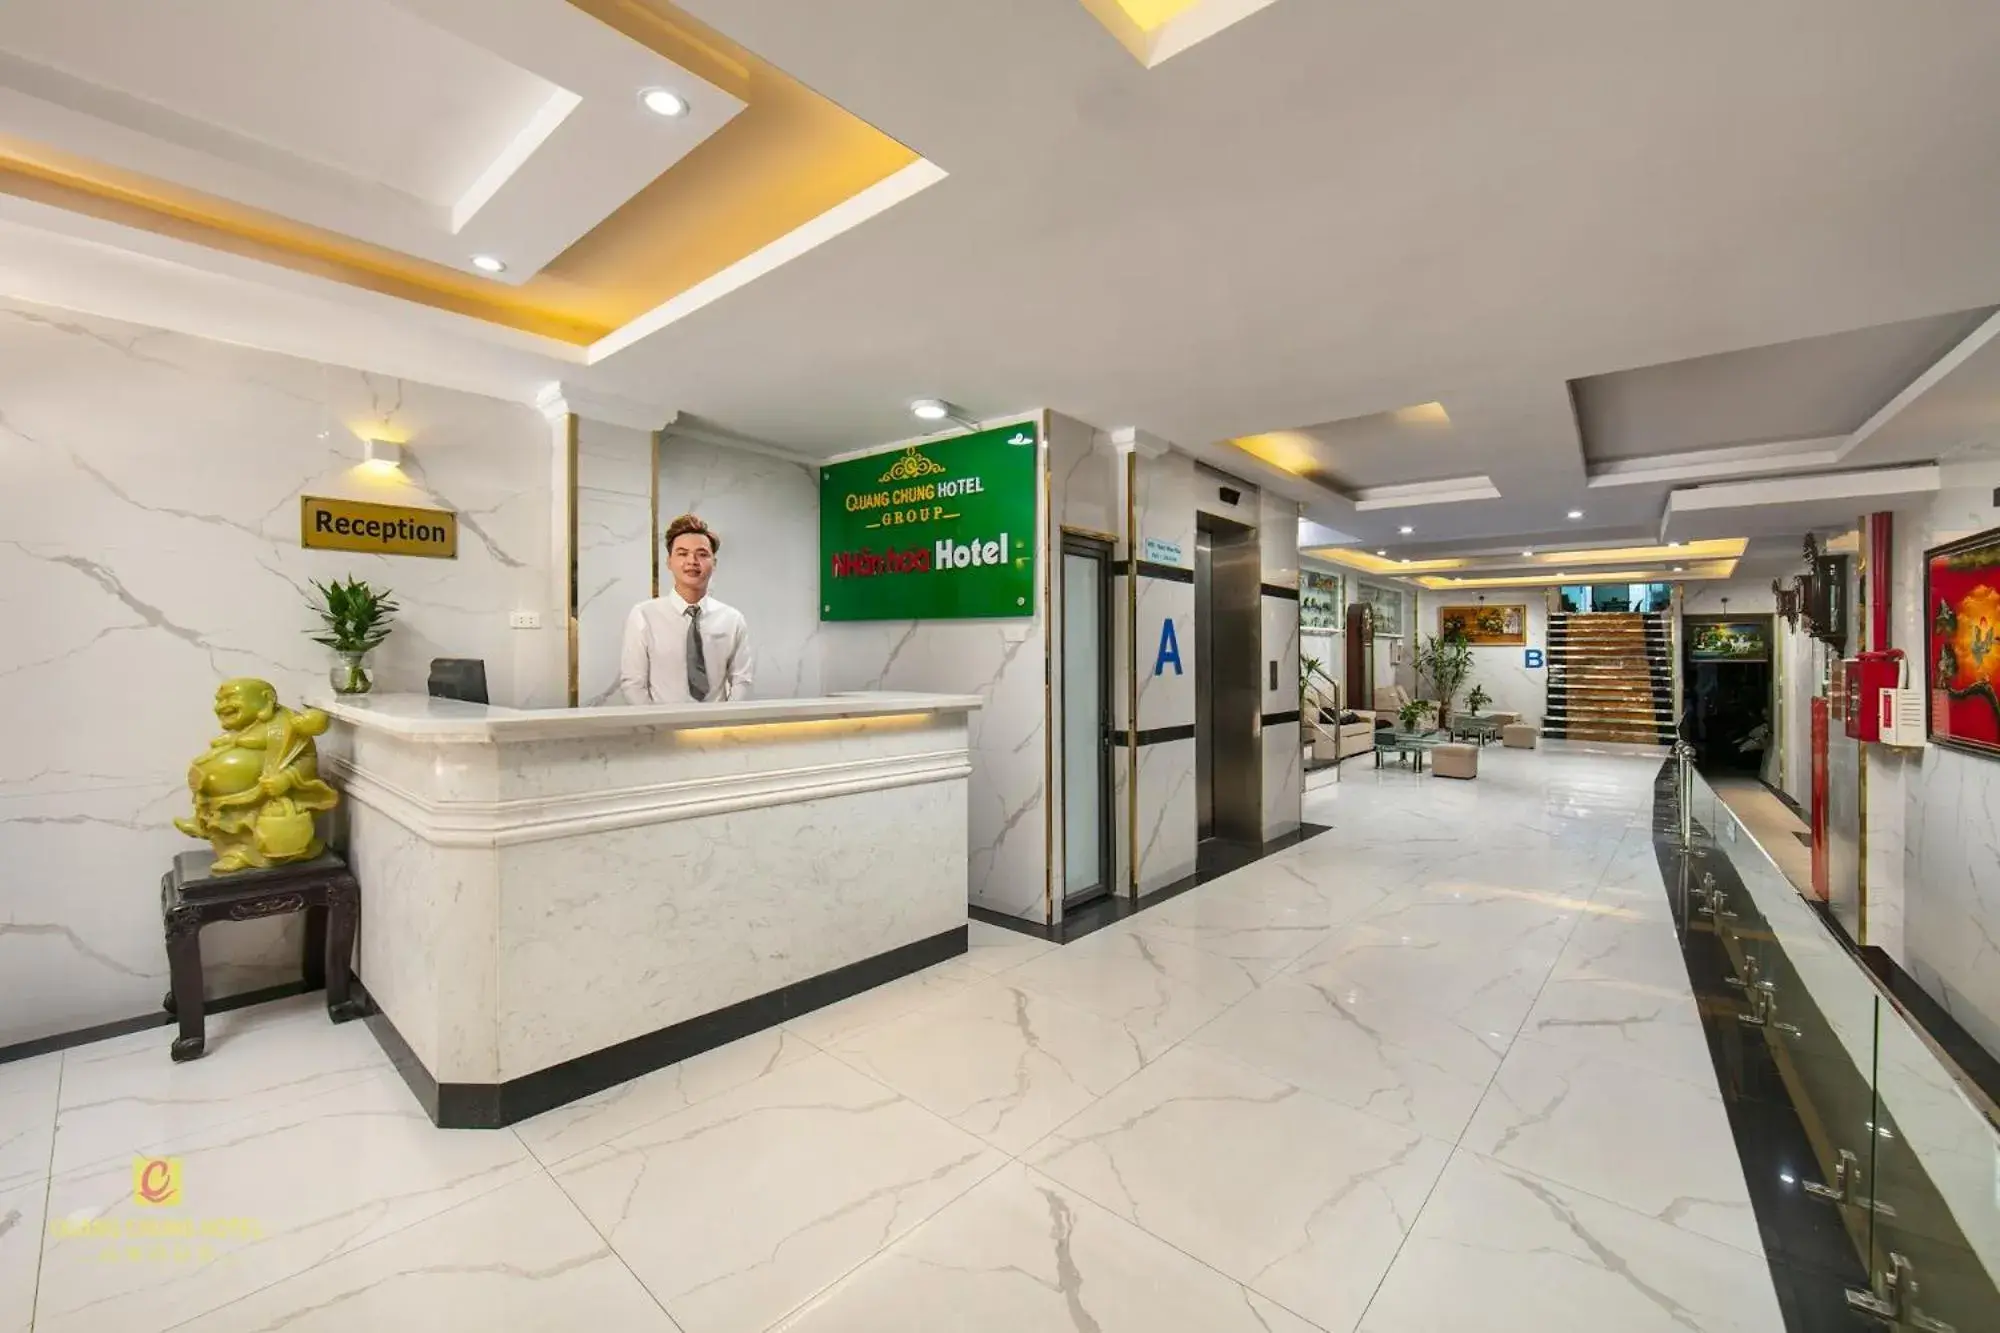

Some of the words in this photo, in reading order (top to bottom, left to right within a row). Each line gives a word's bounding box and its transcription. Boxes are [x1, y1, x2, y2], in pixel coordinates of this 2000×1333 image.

[845, 491, 889, 512] QUANG
[892, 484, 935, 504] CHUNG
[938, 476, 984, 498] HOTEL
[316, 510, 445, 543] Reception
[882, 506, 943, 526] GROUP
[936, 532, 1008, 570] Hotel
[1154, 618, 1183, 675] A
[1525, 649, 1543, 668] B
